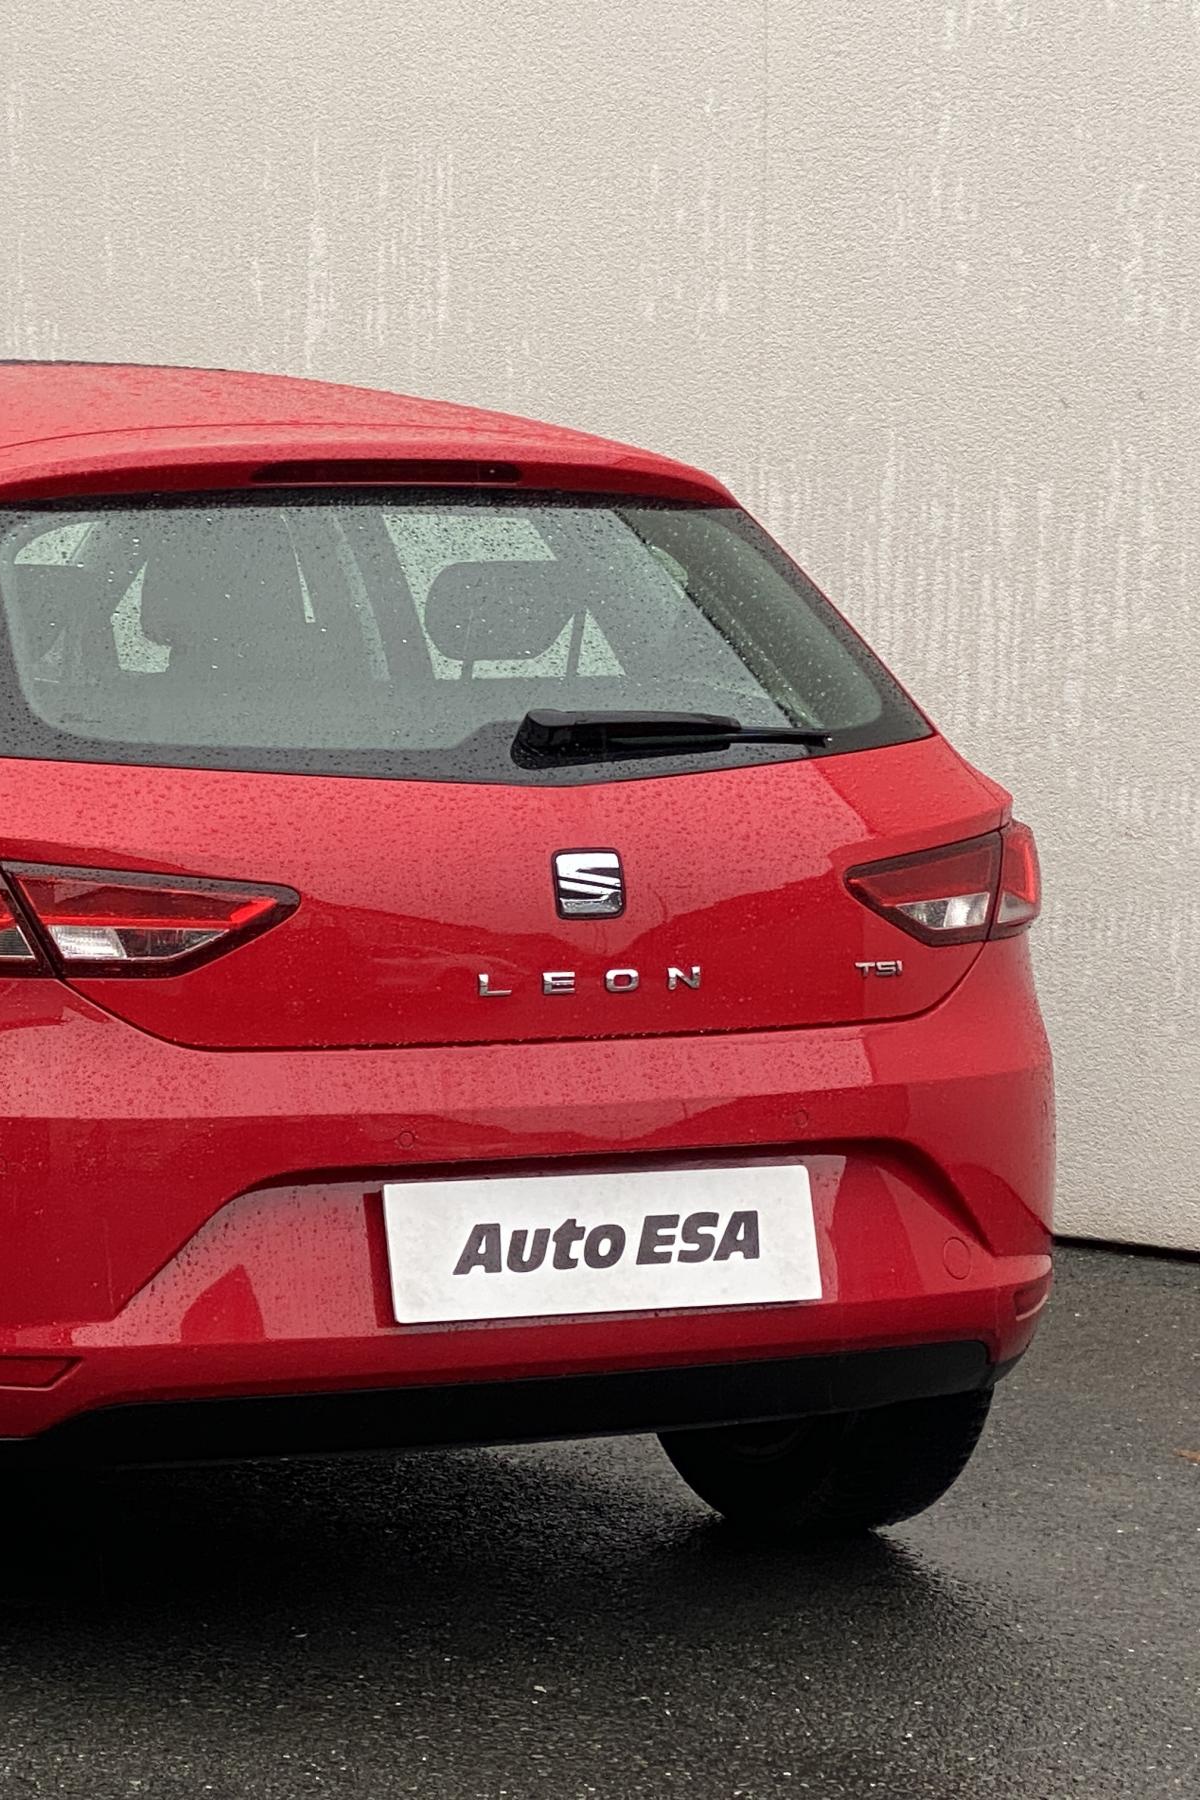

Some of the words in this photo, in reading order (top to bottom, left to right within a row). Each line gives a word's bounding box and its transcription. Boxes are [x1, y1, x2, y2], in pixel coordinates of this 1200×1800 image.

[478, 966, 700, 997] LEON
[854, 960, 903, 976] TSI
[453, 1218, 626, 1275] Auto
[636, 1210, 760, 1265] ESA
